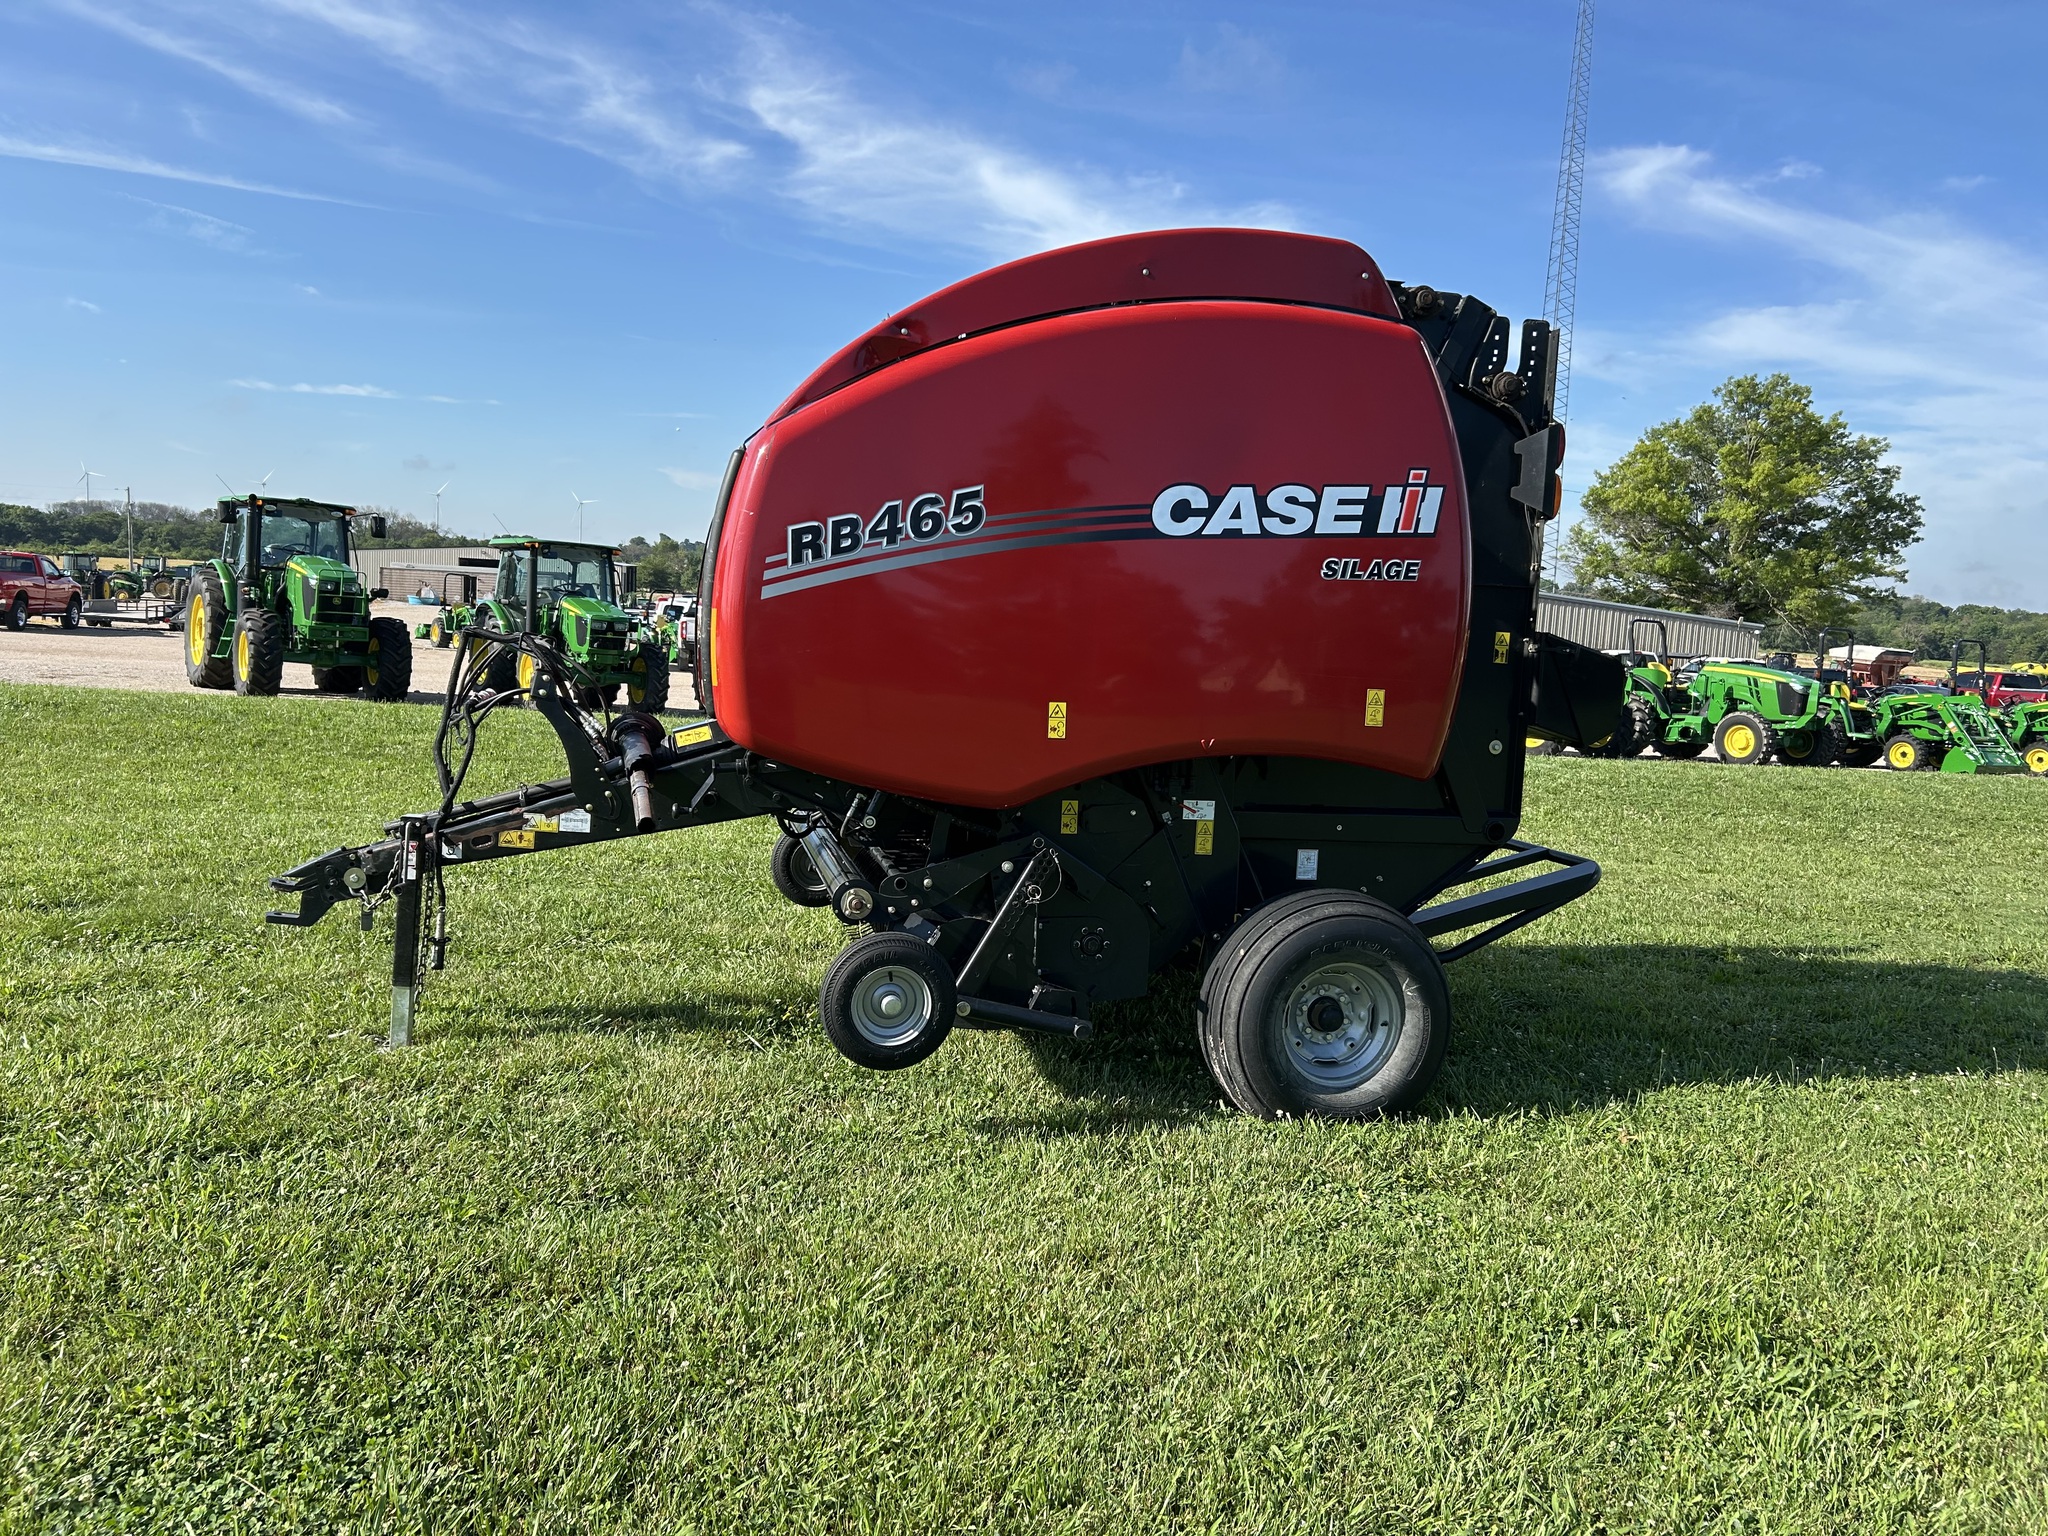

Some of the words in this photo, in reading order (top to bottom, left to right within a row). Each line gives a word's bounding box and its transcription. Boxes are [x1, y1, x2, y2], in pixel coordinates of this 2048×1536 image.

[787, 484, 986, 569] RB465
[1151, 484, 1370, 536] CASE
[1320, 557, 1422, 581] SILAGE
[855, 949, 899, 973] TRAIL
